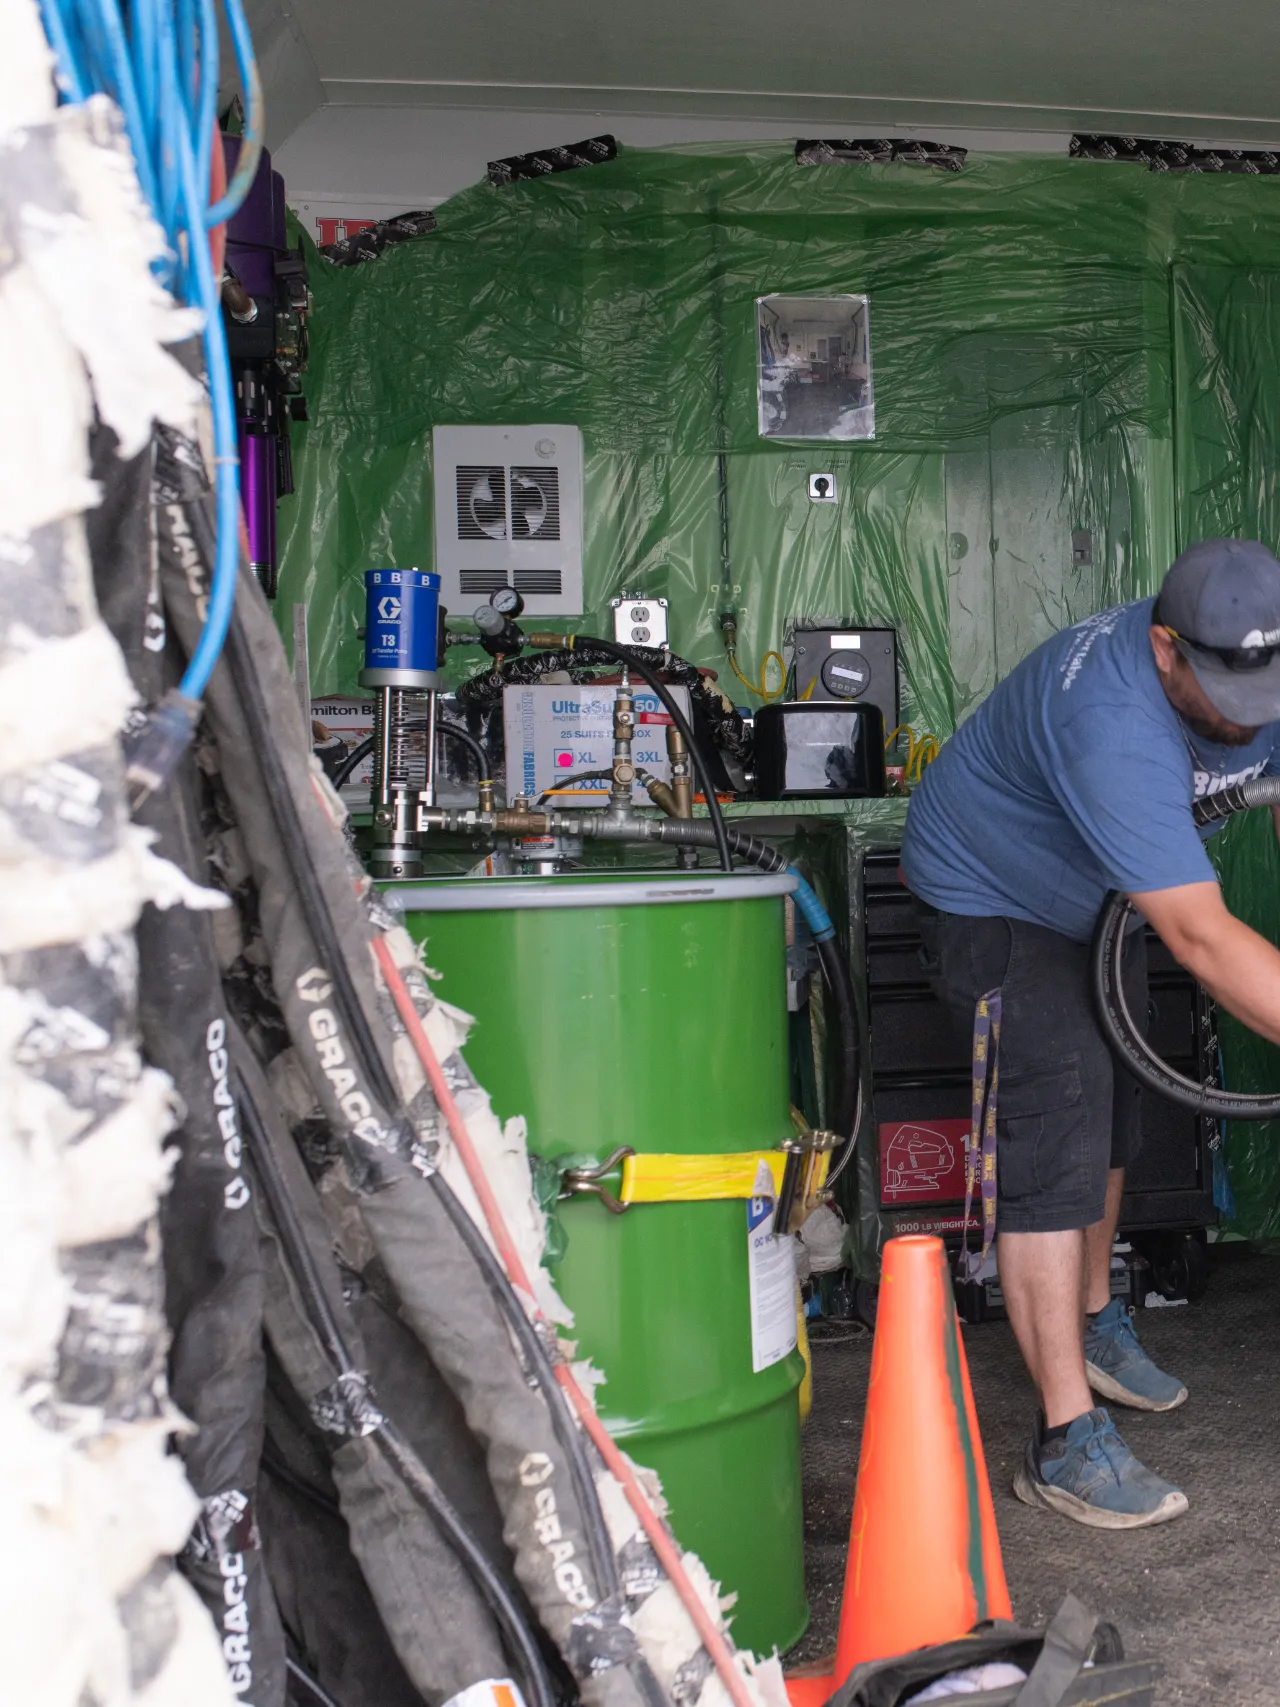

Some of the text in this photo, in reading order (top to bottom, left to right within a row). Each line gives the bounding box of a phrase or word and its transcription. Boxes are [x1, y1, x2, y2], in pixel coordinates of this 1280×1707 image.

[374, 572, 430, 586] B B B
[382, 634, 396, 647] T3
[311, 705, 358, 716] milton
[552, 699, 656, 714] UltraSu 50
[575, 730, 605, 738] SUITS
[578, 752, 663, 764] XL 3XL
[523, 751, 536, 796] FABRICS
[578, 779, 608, 790] XXL
[308, 1008, 381, 1147] GRACO
[206, 1018, 242, 1169] GRACO
[895, 1222, 919, 1233] 1000
[922, 1221, 931, 1231] LB
[534, 1488, 596, 1610] GRACO
